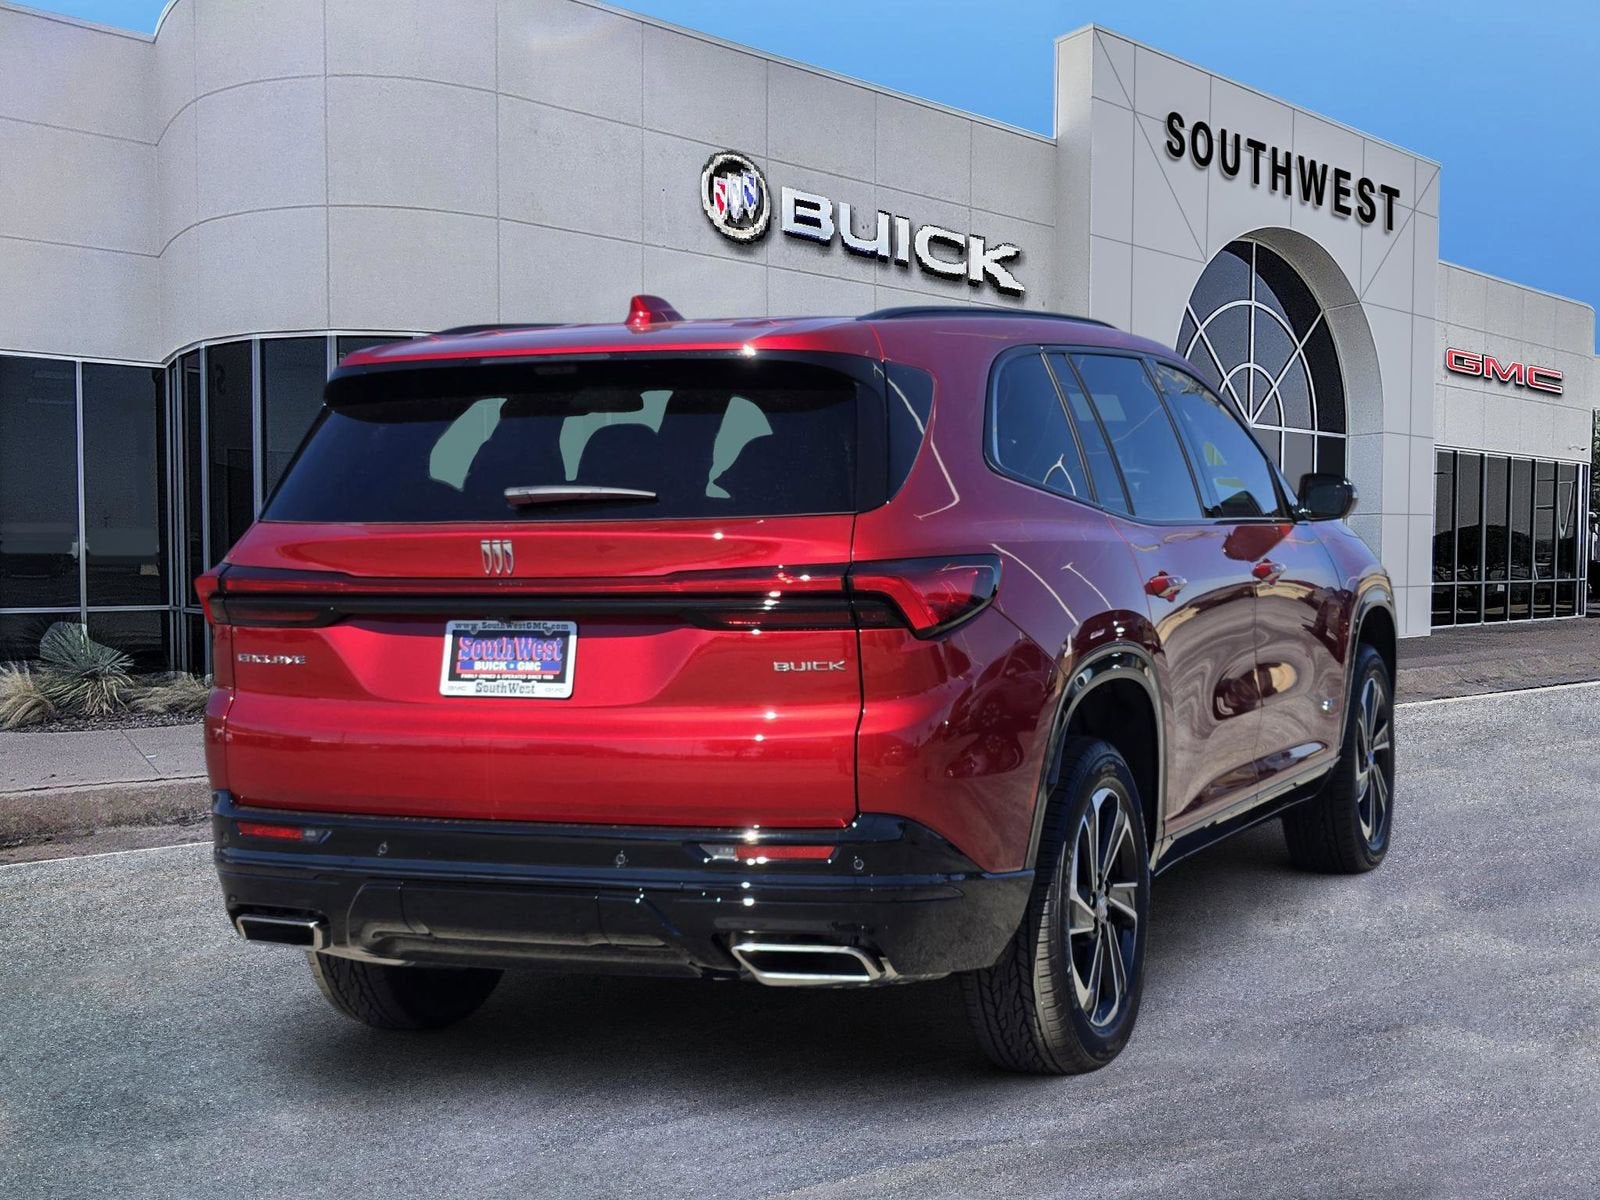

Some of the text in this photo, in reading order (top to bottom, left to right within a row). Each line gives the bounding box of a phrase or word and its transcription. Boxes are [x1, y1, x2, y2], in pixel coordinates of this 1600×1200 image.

[1166, 111, 1400, 231] SOUTHWEST
[781, 186, 1025, 297] BUICK
[1446, 347, 1563, 394] GMC
[457, 636, 563, 661] SouthWest
[474, 661, 542, 671] BUICK GMC
[773, 661, 846, 672] BUICK
[475, 682, 535, 694] SouthWest
